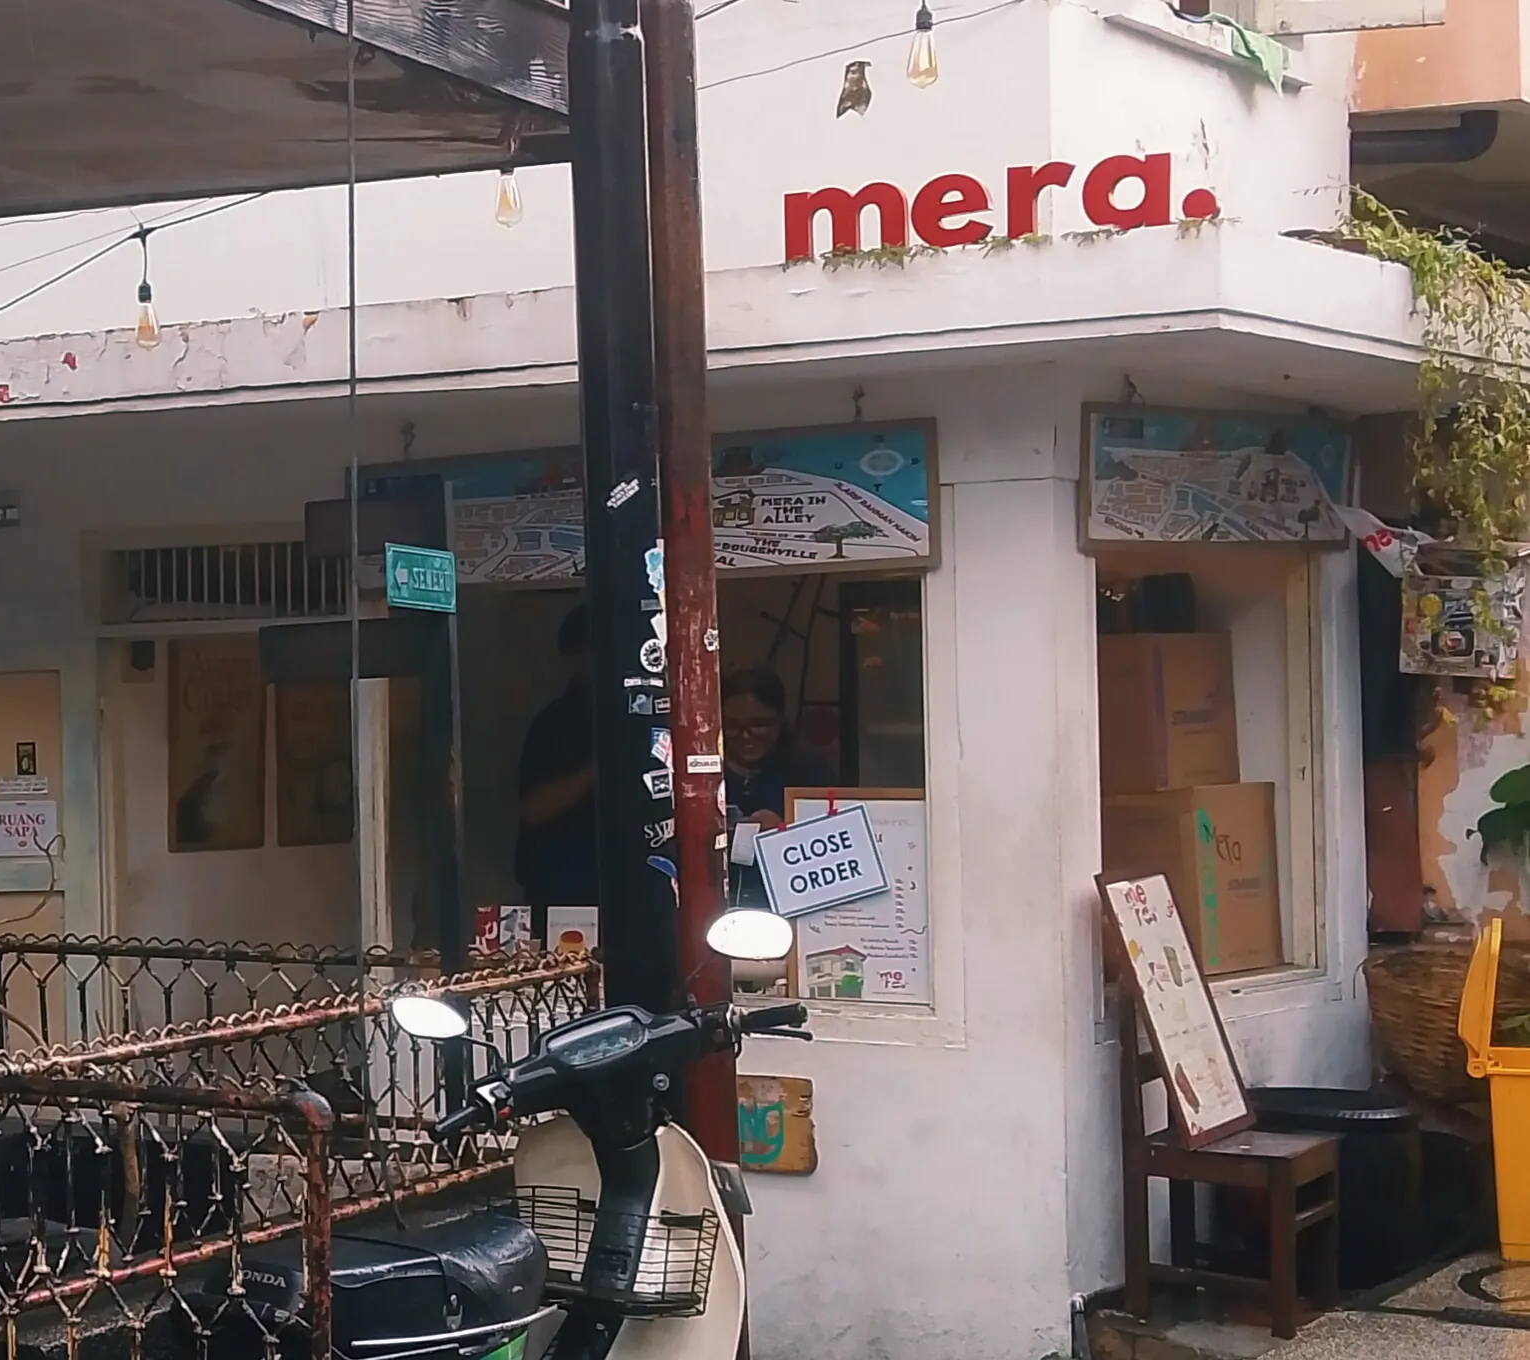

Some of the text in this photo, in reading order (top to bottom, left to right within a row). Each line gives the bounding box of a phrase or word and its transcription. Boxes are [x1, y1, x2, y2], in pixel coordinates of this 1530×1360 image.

[783, 152, 1221, 264] mera.
[761, 496, 827, 506] MERA IN
[773, 506, 804, 516] THE
[763, 514, 815, 524] ALLEY
[754, 538, 781, 547] THE
[4, 826, 38, 837] SAPA
[783, 830, 853, 865] CLOSE
[790, 859, 863, 894] ORDER
